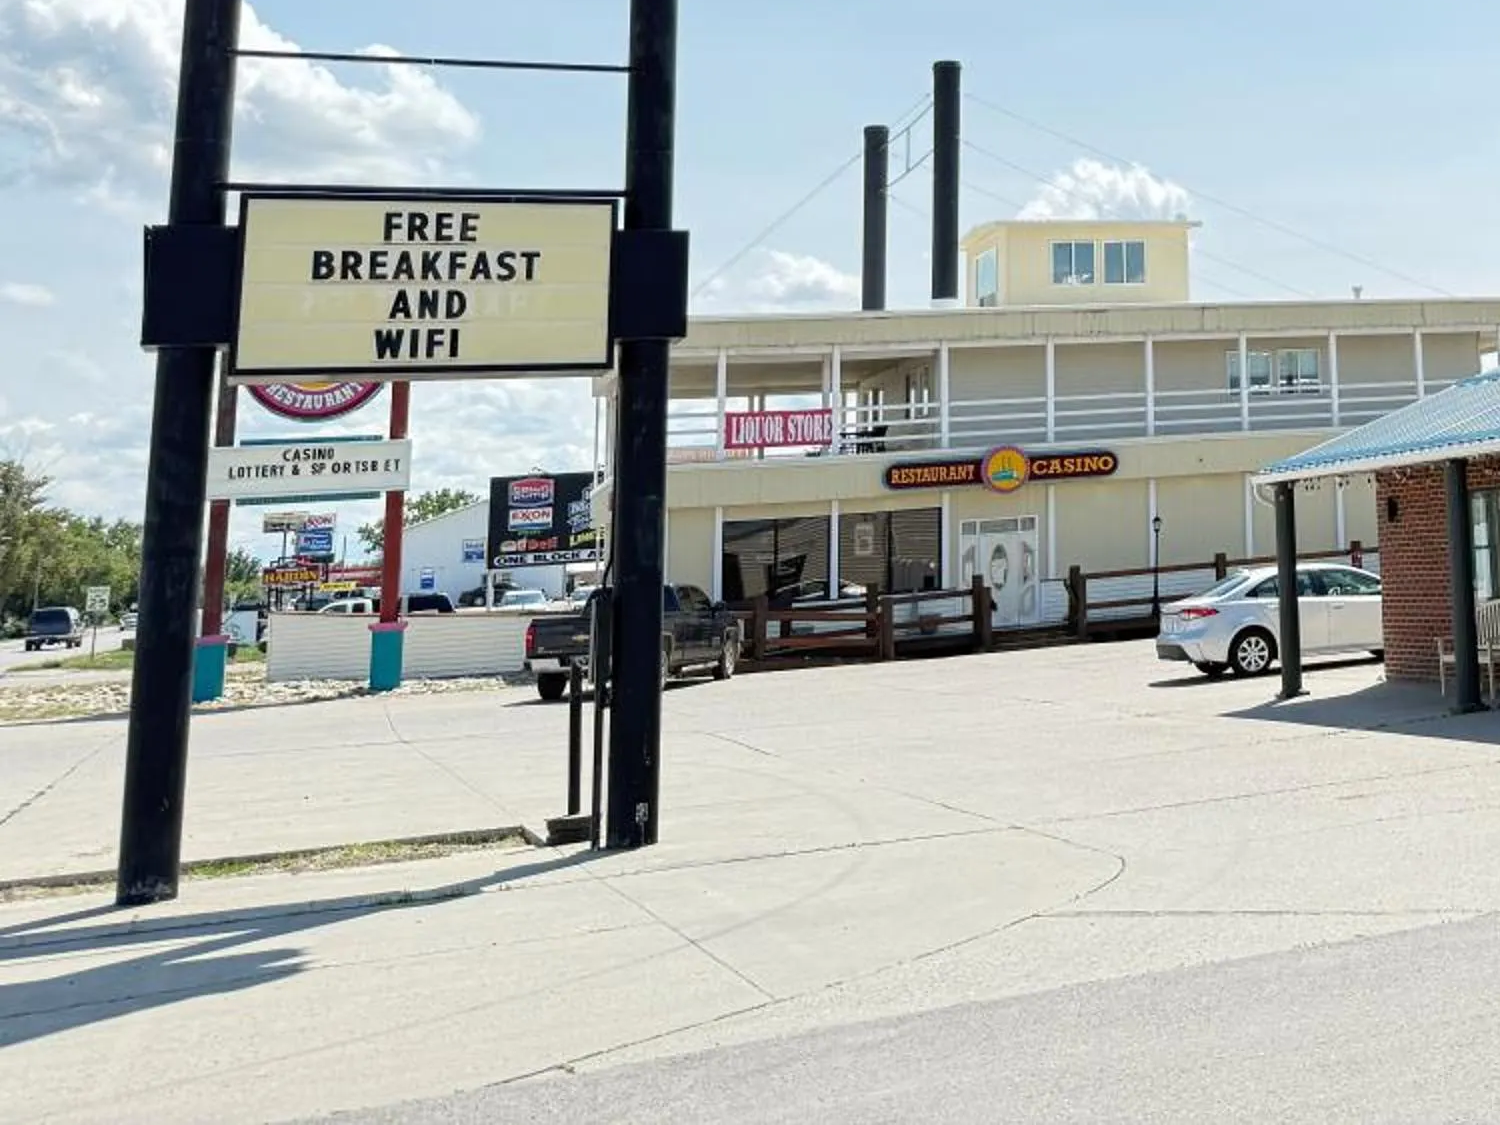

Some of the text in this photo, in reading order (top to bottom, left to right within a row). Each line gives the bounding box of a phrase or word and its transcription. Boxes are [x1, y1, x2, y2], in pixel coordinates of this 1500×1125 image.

[383, 213, 481, 242] FREE
[311, 250, 541, 281] BREAKFAST
[388, 290, 467, 320] AND
[375, 328, 460, 359] WIFI
[265, 382, 364, 409] RESTAURANT
[731, 413, 832, 444] LIQUOR STORE
[283, 448, 335, 462] CASINO
[228, 464, 286, 480] LOTTERY
[291, 463, 300, 476] &
[891, 456, 1115, 484] RESTAURANT CASINO
[511, 510, 550, 522] EXXON
